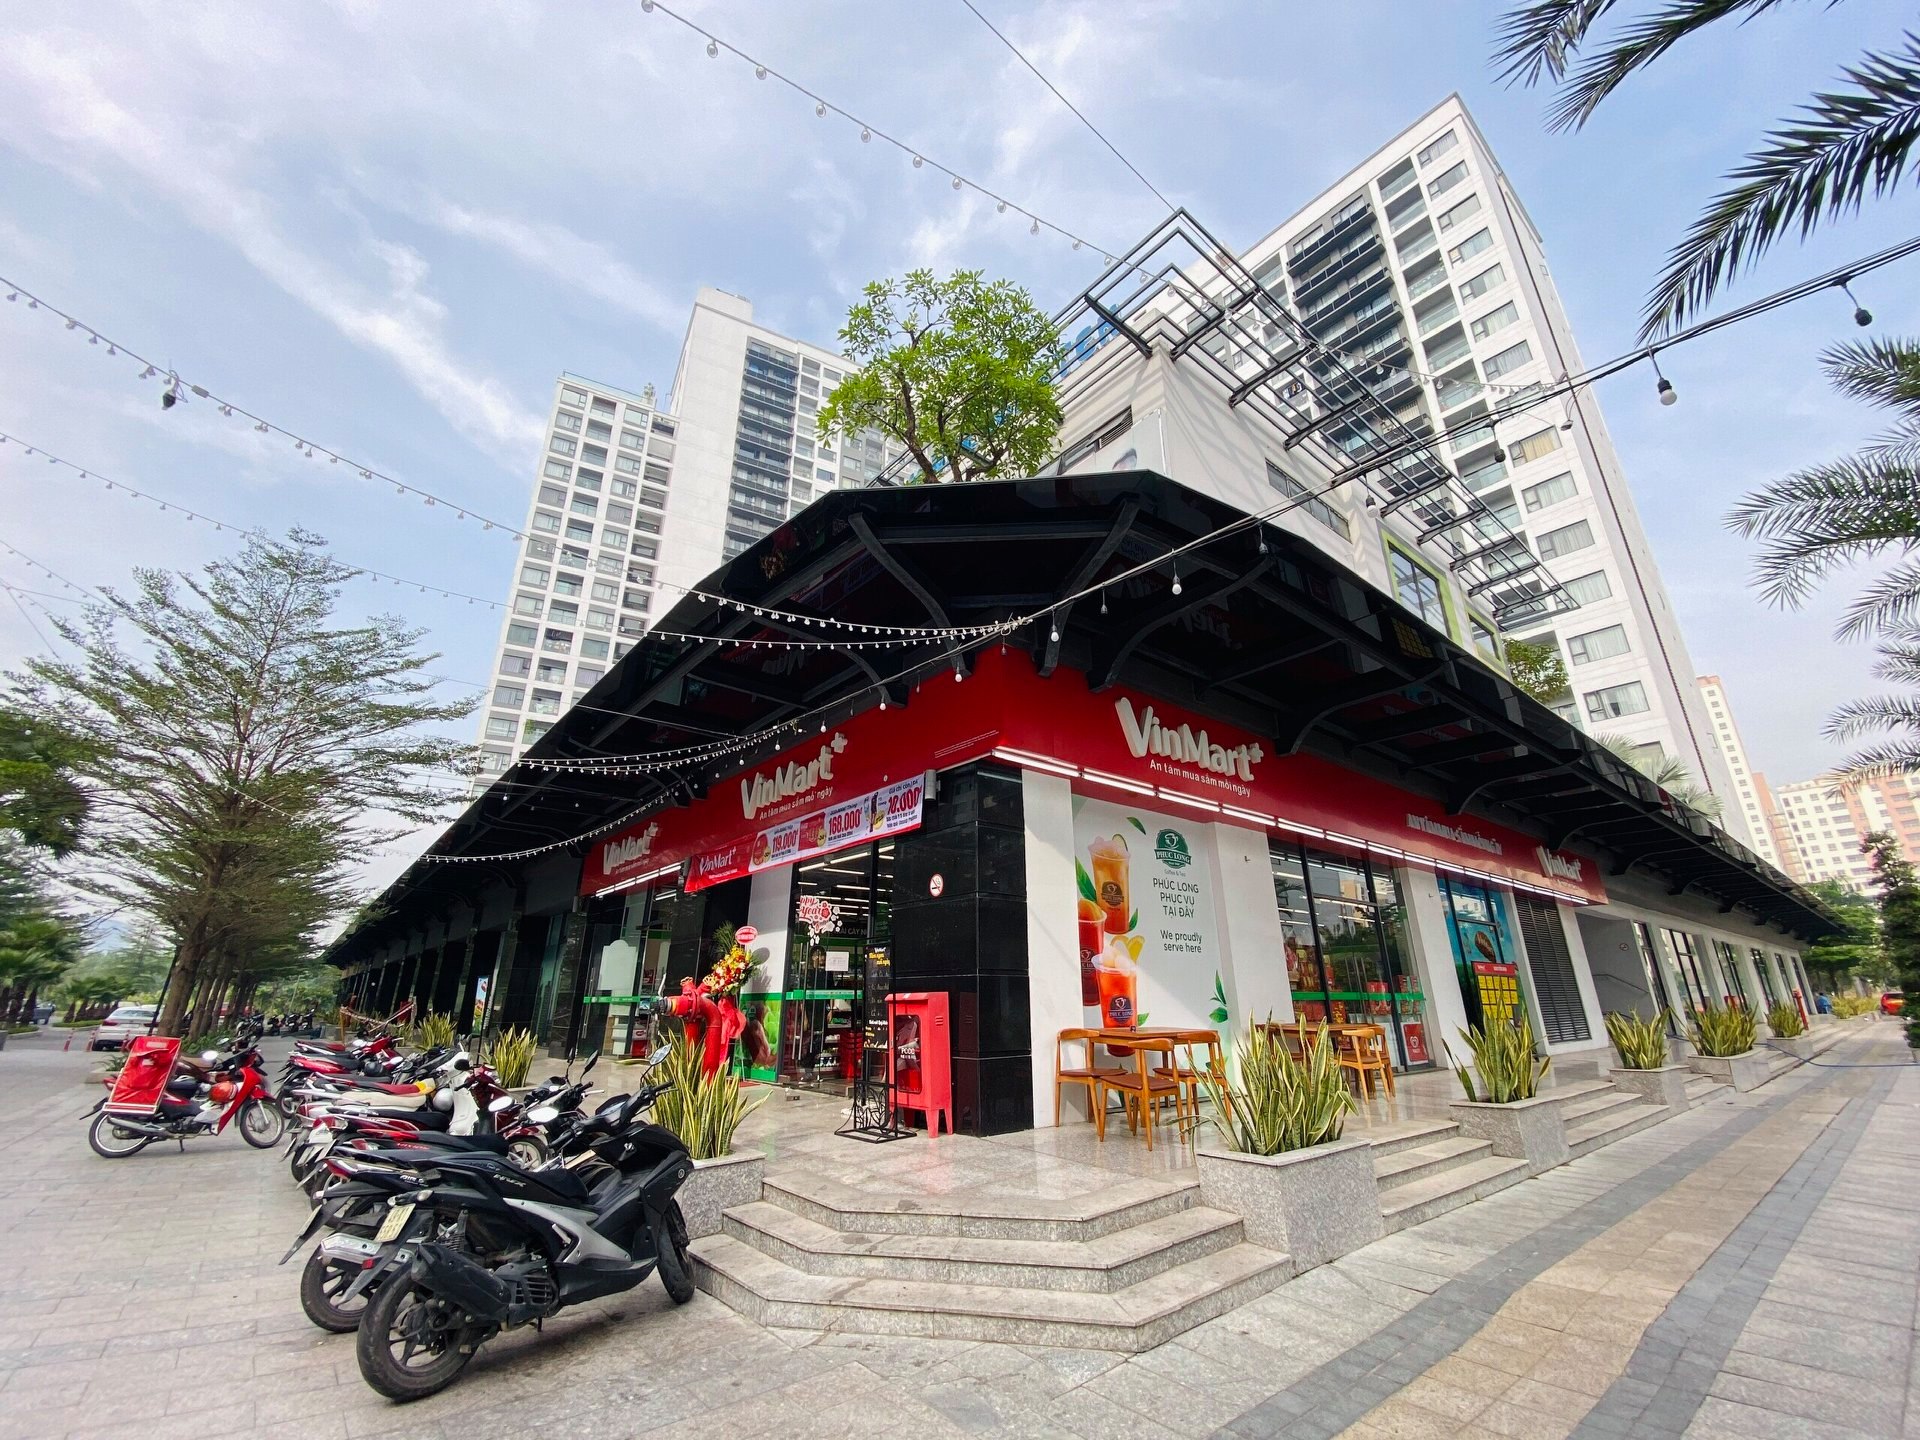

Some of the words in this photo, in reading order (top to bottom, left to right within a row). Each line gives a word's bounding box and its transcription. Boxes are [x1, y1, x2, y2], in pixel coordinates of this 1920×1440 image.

[1150, 759, 1162, 771] An
[1182, 770, 1200, 782] mua
[1232, 784, 1251, 798] ngày
[1174, 853, 1190, 863] LONG
[1153, 877, 1175, 890] PHÚC
[1177, 883, 1199, 894] LONG
[1160, 930, 1173, 940] We
[1175, 932, 1202, 944] proudly
[1164, 943, 1184, 952] serve
[1186, 943, 1202, 953] here
